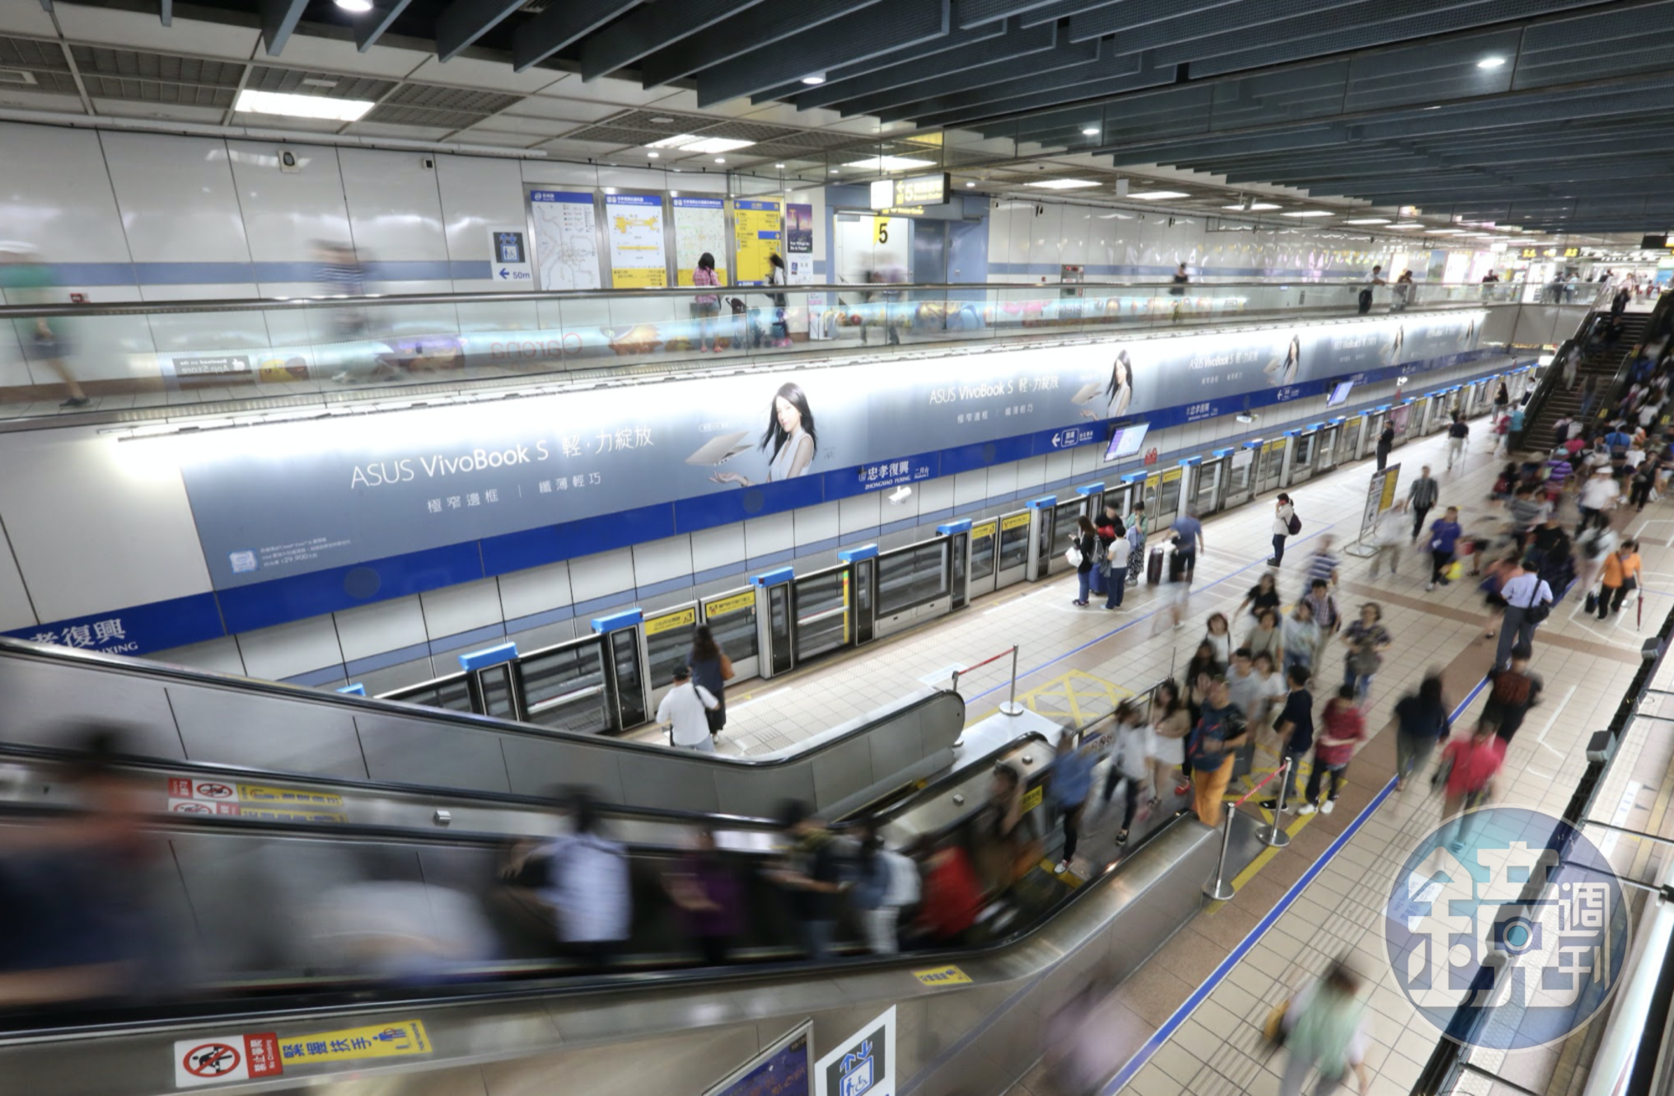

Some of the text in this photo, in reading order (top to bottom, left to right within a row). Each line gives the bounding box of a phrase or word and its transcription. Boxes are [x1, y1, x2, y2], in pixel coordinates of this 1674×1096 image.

[904, 183, 913, 202] 5
[878, 222, 888, 244] 5
[512, 271, 531, 280] 50m
[929, 385, 956, 405] ASUS
[958, 381, 1005, 401] VivoBook
[1007, 381, 1014, 395] S
[350, 458, 415, 489] ASUS
[420, 444, 531, 478] VivoBook
[536, 439, 549, 461] S
[867, 460, 910, 481] 忠孝復興
[426, 472, 602, 514] 極窄邊框 纖薄輕巧
[864, 475, 912, 490] ZHONGXIAO FUXING
[282, 1037, 373, 1059] 緊握扶手
